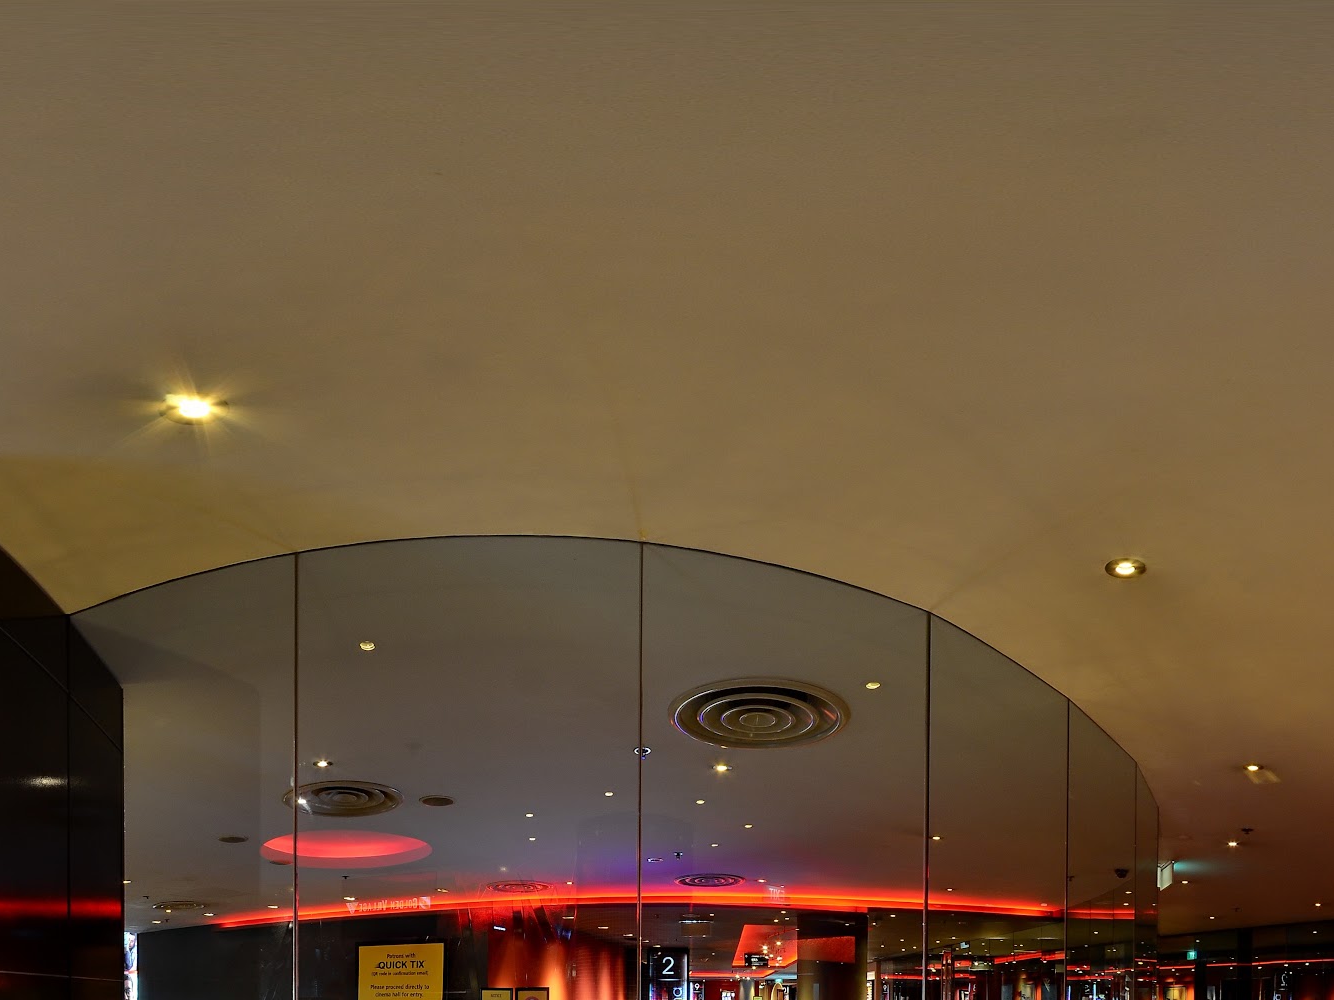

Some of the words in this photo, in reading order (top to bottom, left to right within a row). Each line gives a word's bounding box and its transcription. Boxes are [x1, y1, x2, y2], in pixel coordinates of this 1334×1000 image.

[378, 960, 407, 970] QUICK
[410, 960, 425, 969] TIX
[662, 956, 675, 975] 2
[405, 983, 423, 991] directly
[694, 982, 700, 990] 9
